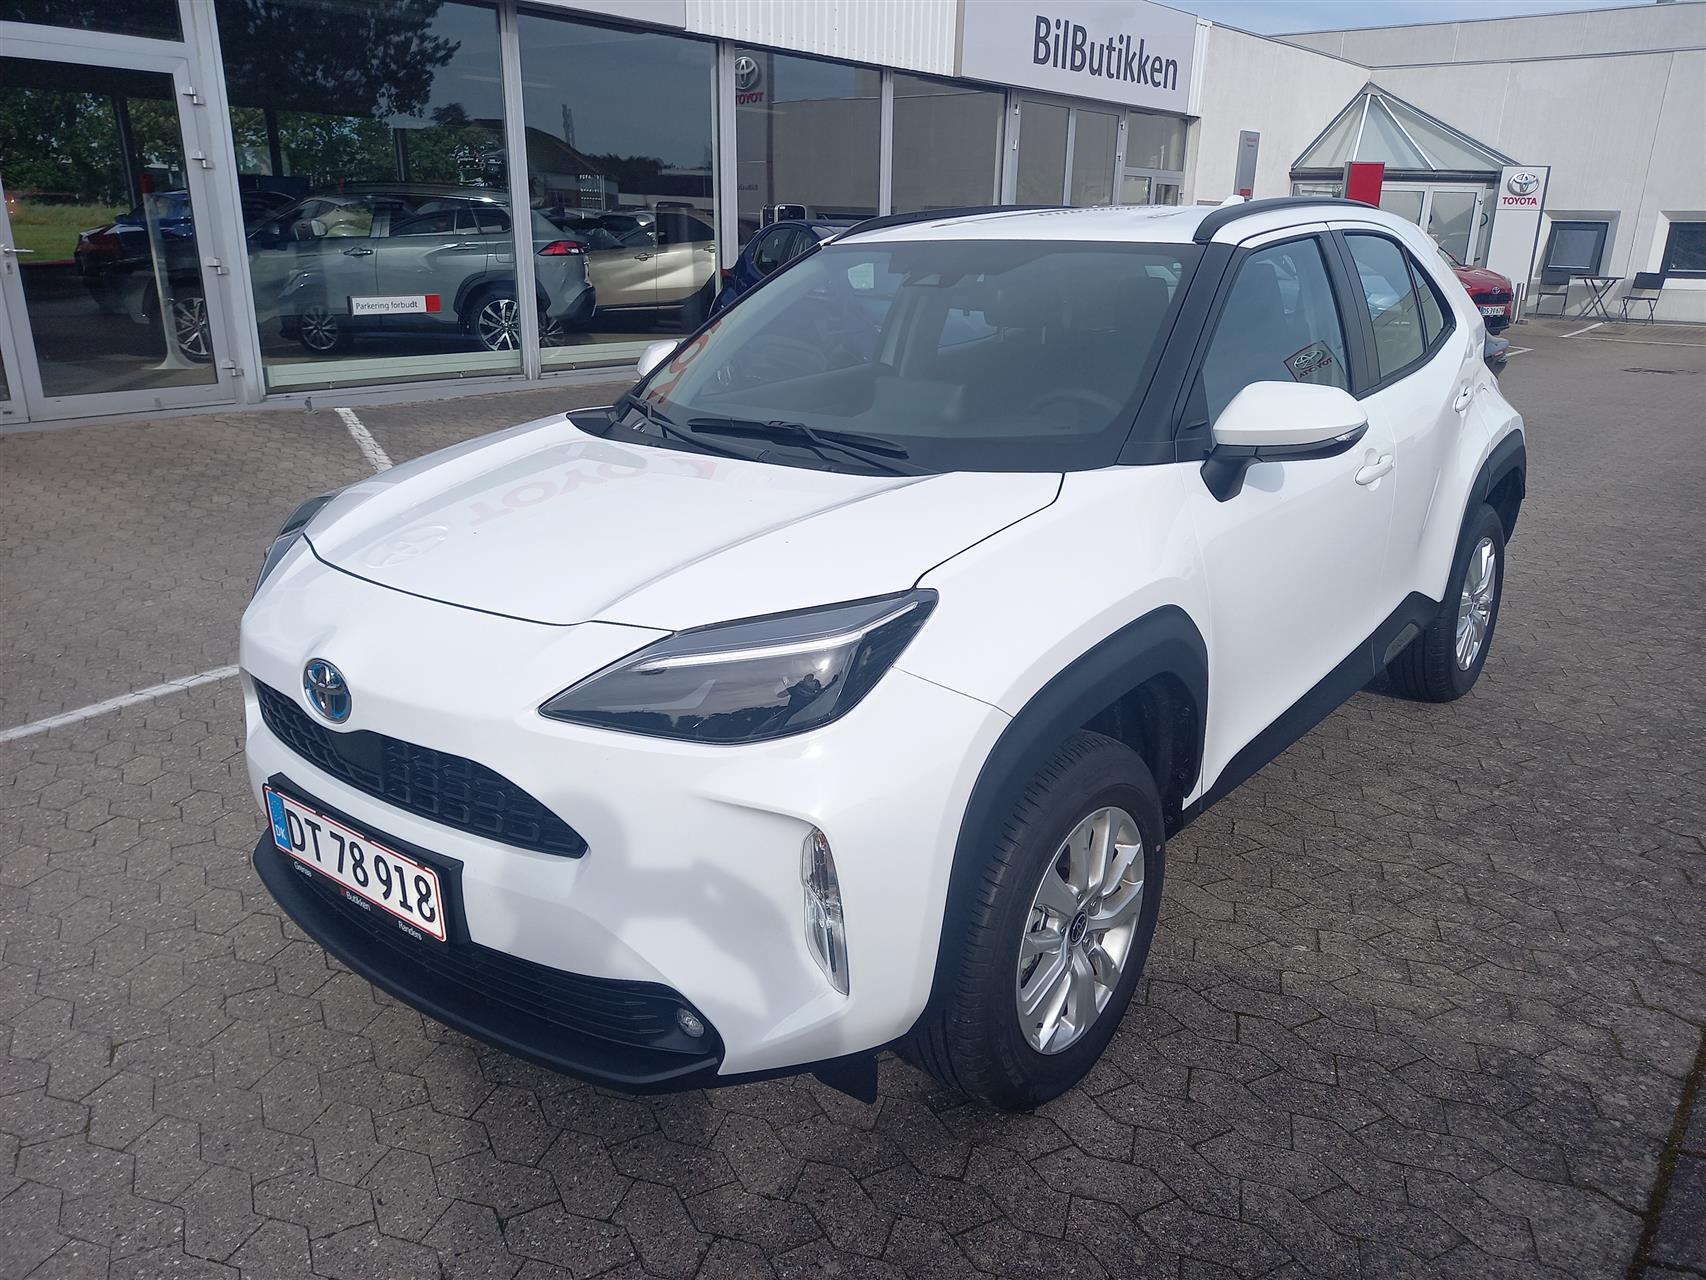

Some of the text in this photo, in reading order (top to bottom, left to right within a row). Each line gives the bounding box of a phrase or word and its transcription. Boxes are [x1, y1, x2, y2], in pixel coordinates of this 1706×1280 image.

[1033, 15, 1178, 91] BilButikken
[1502, 196, 1537, 206] TOYOTA
[356, 301, 418, 311] Parkering forbudt
[275, 824, 287, 841] DK
[286, 808, 322, 863] DT
[398, 920, 422, 941] Randers
